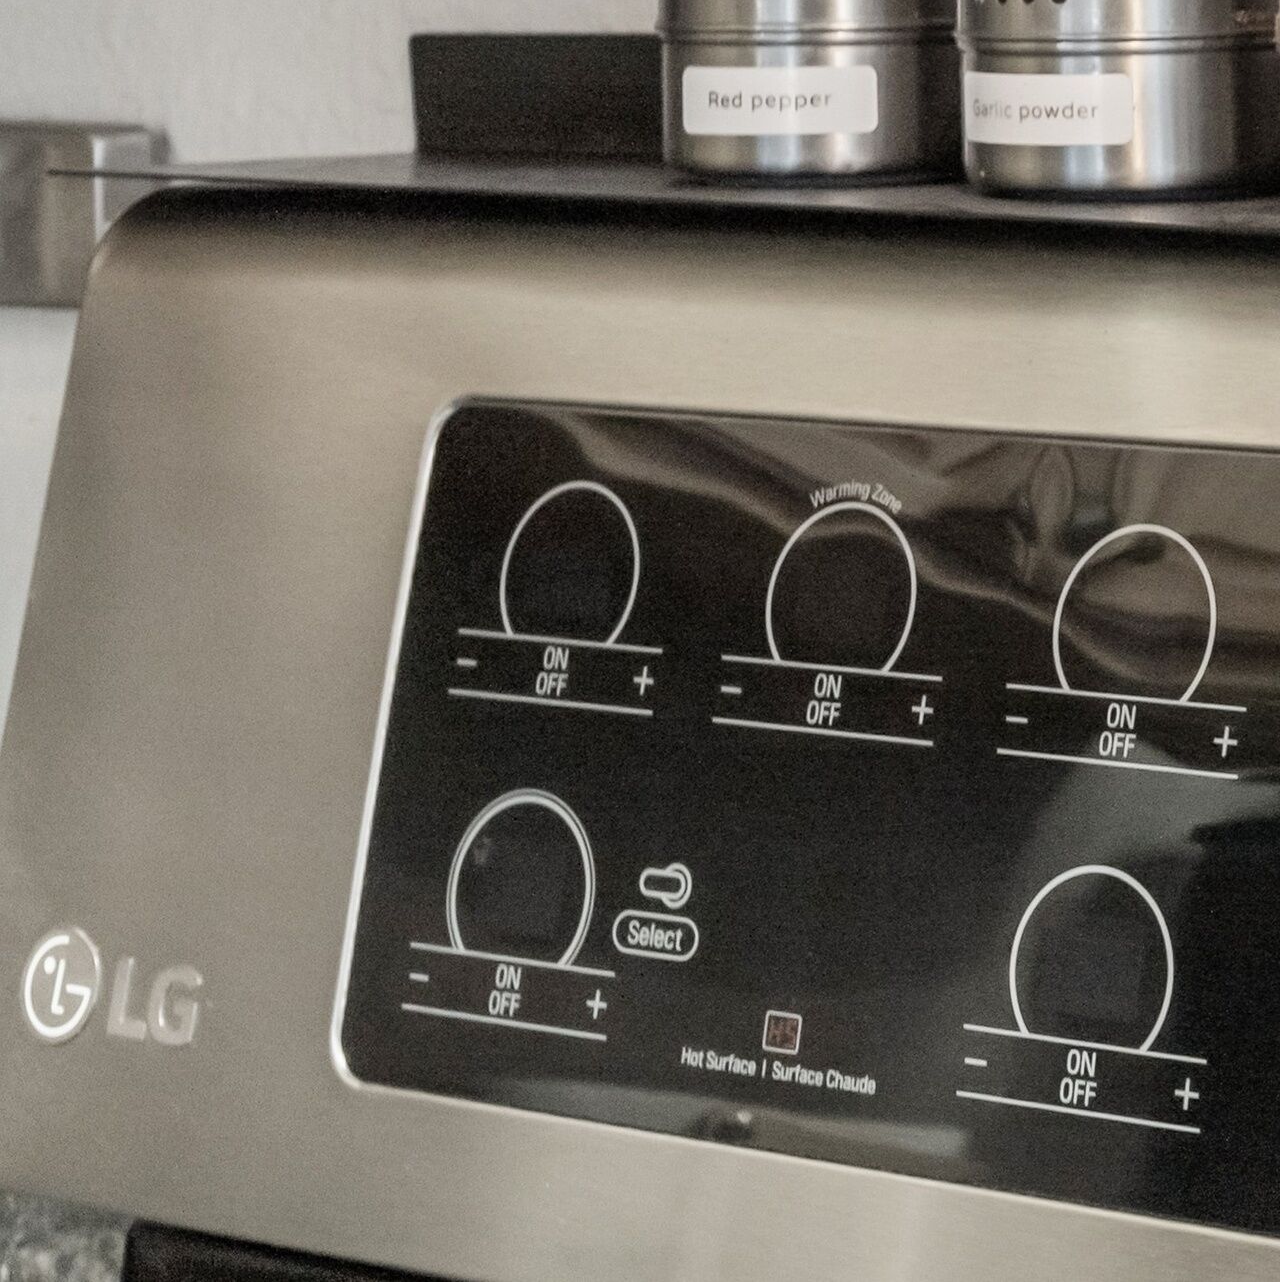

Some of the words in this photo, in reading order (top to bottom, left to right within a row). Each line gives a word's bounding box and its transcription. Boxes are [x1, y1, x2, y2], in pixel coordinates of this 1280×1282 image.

[708, 90, 743, 109] Red
[750, 92, 831, 113] pepper
[1018, 101, 1098, 124] powder
[809, 480, 871, 509] Warming
[871, 483, 902, 514] Zone
[543, 645, 571, 672] ON
[535, 672, 569, 698] OFF
[813, 671, 843, 699] ON
[805, 700, 842, 728] OFF
[1106, 702, 1137, 730] ON
[1098, 731, 1137, 760] OFF
[625, 920, 684, 955] Select
[495, 965, 522, 991] ON
[105, 957, 203, 1046] LG
[487, 992, 521, 1019] OFF
[680, 1046, 704, 1069] Hot
[705, 1050, 758, 1076] Surface
[771, 1060, 825, 1087] Surface
[825, 1068, 877, 1096] Chaude
[1065, 1048, 1097, 1079] ON
[1058, 1078, 1097, 1109] OFF
